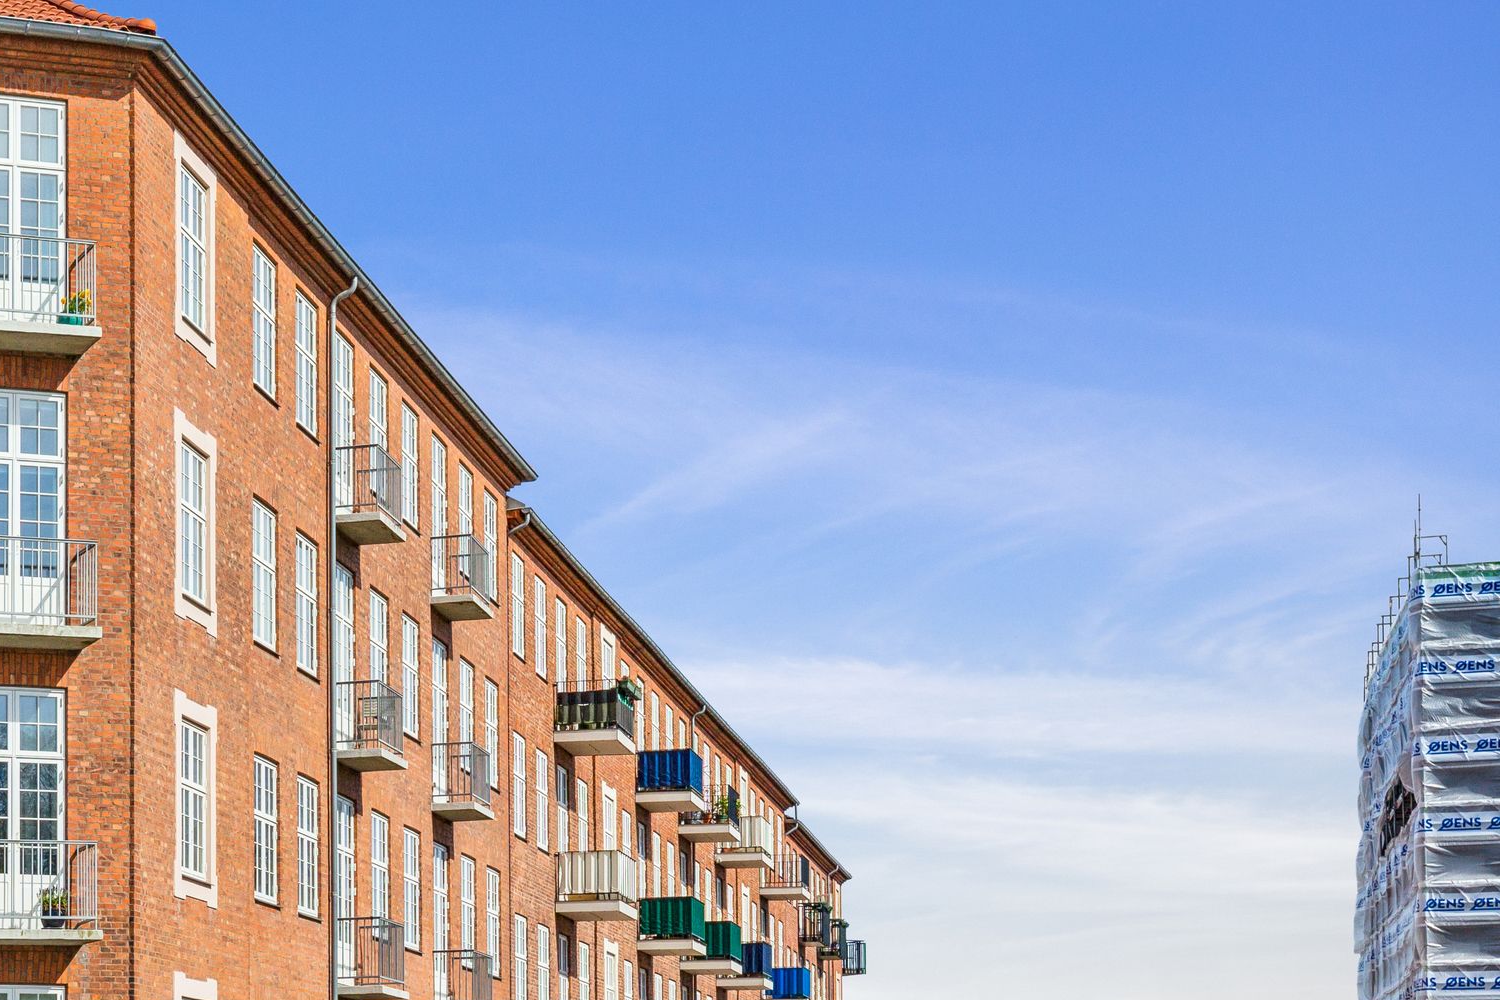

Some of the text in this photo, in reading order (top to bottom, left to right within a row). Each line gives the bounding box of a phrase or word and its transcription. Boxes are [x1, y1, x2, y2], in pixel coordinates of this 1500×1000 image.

[1431, 583, 1474, 597] ØENS
[1415, 660, 1495, 676] ENS ØENS
[1426, 740, 1468, 754] ØENS
[1474, 738, 1500, 752] ØE
[1438, 817, 1481, 831] ØENS
[1423, 898, 1465, 911] ØENS
[1442, 977, 1485, 990] ØENS
